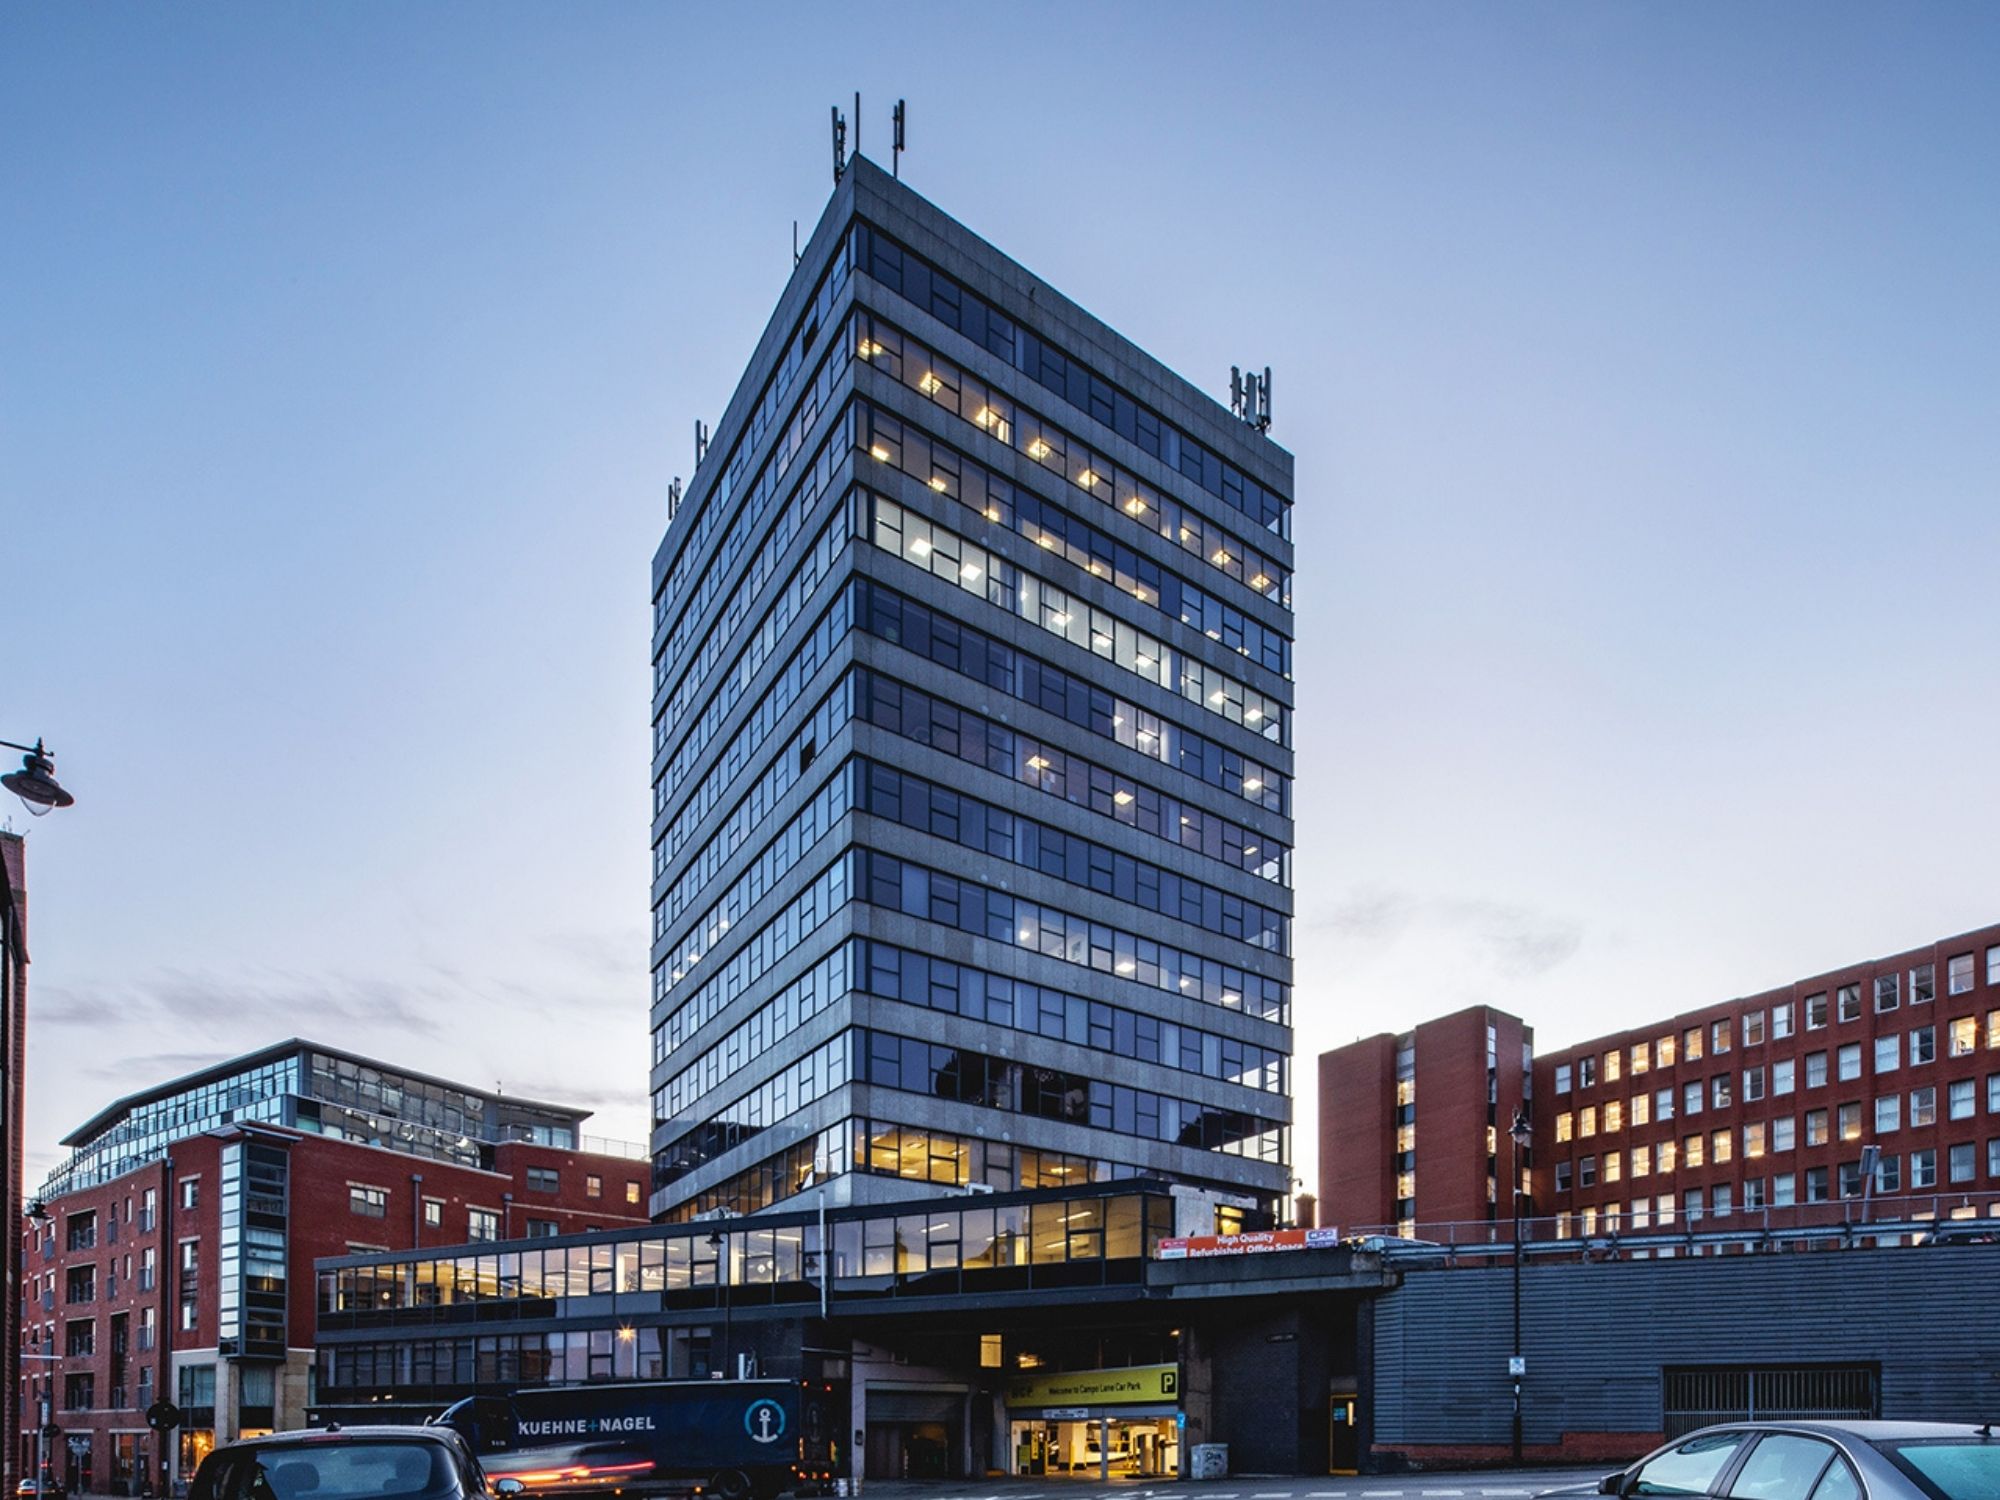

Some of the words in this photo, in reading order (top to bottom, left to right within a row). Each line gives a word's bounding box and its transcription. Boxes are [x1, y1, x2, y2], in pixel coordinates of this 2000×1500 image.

[1217, 1235, 1239, 1245] High
[1239, 1232, 1275, 1244] Quality
[1190, 1245, 1244, 1257] Refurbished
[1247, 1243, 1275, 1254] Office
[1048, 1386, 1073, 1395] Welcome
[1079, 1383, 1099, 1395] Campo
[1100, 1383, 1115, 1393] Lane
[1116, 1382, 1126, 1392] Car
[1127, 1381, 1142, 1391] Park
